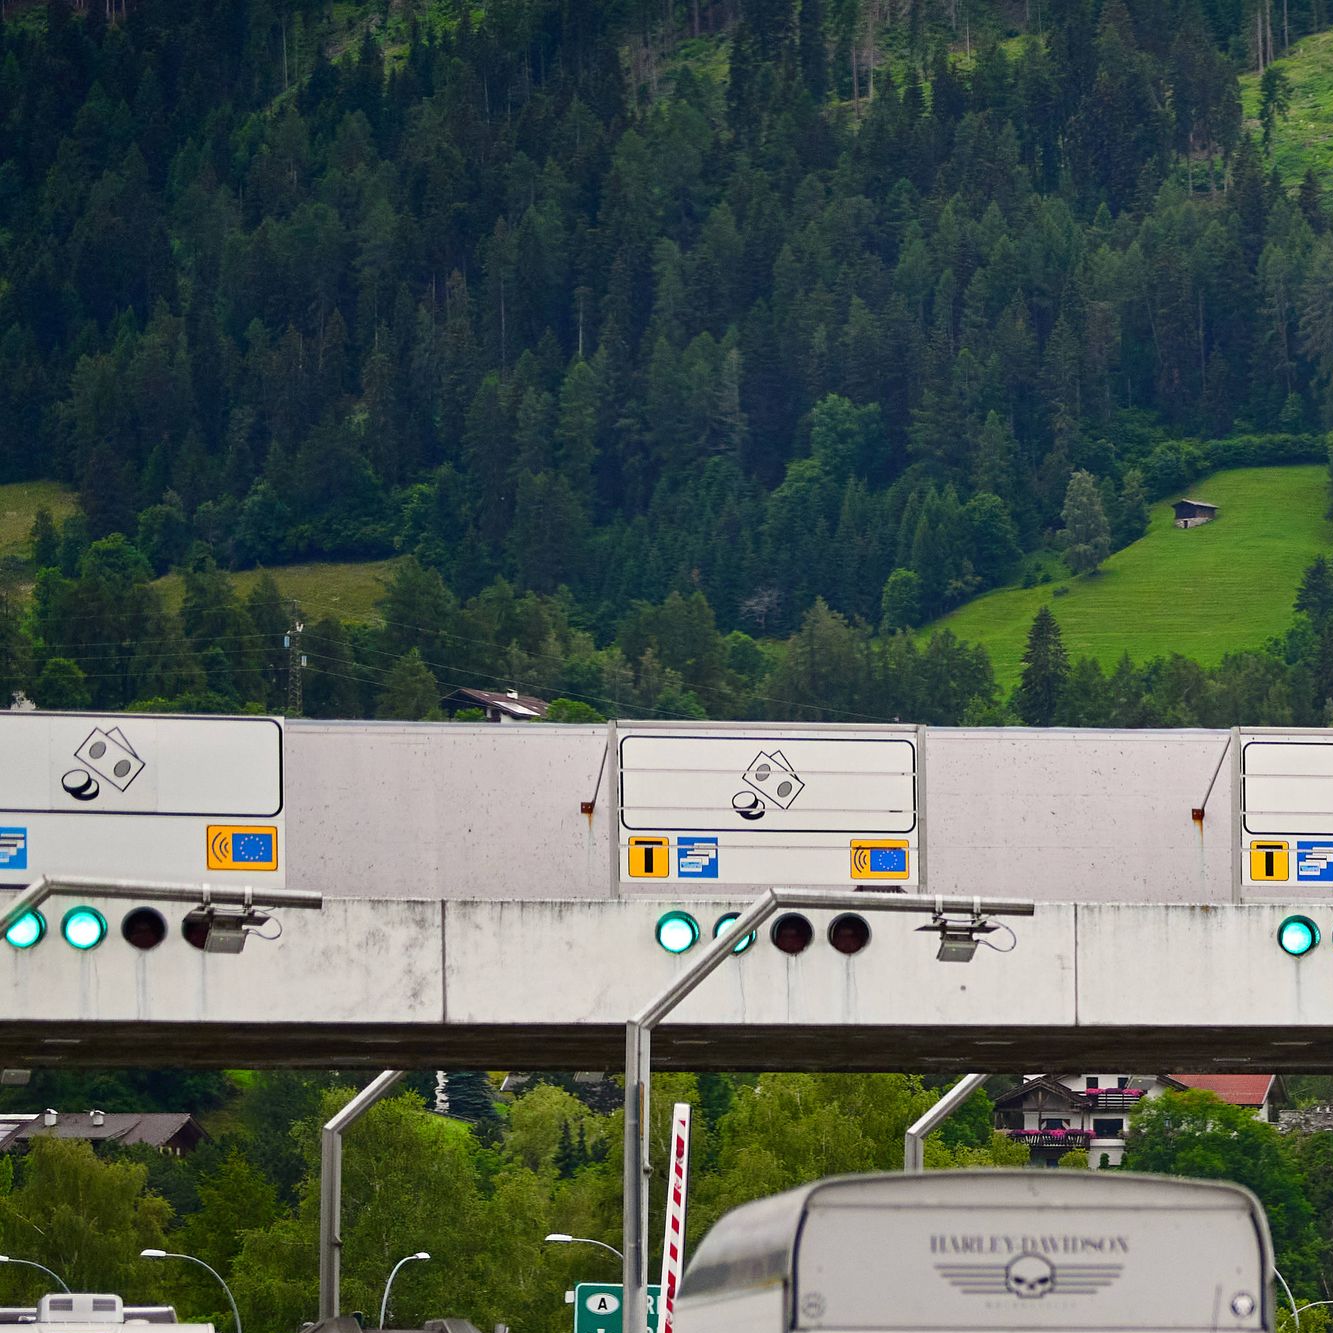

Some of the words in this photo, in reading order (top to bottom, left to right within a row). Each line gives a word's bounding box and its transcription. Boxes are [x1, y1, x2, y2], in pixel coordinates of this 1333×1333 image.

[635, 841, 662, 873] T
[1256, 845, 1283, 876] T
[597, 1297, 608, 1310] A
